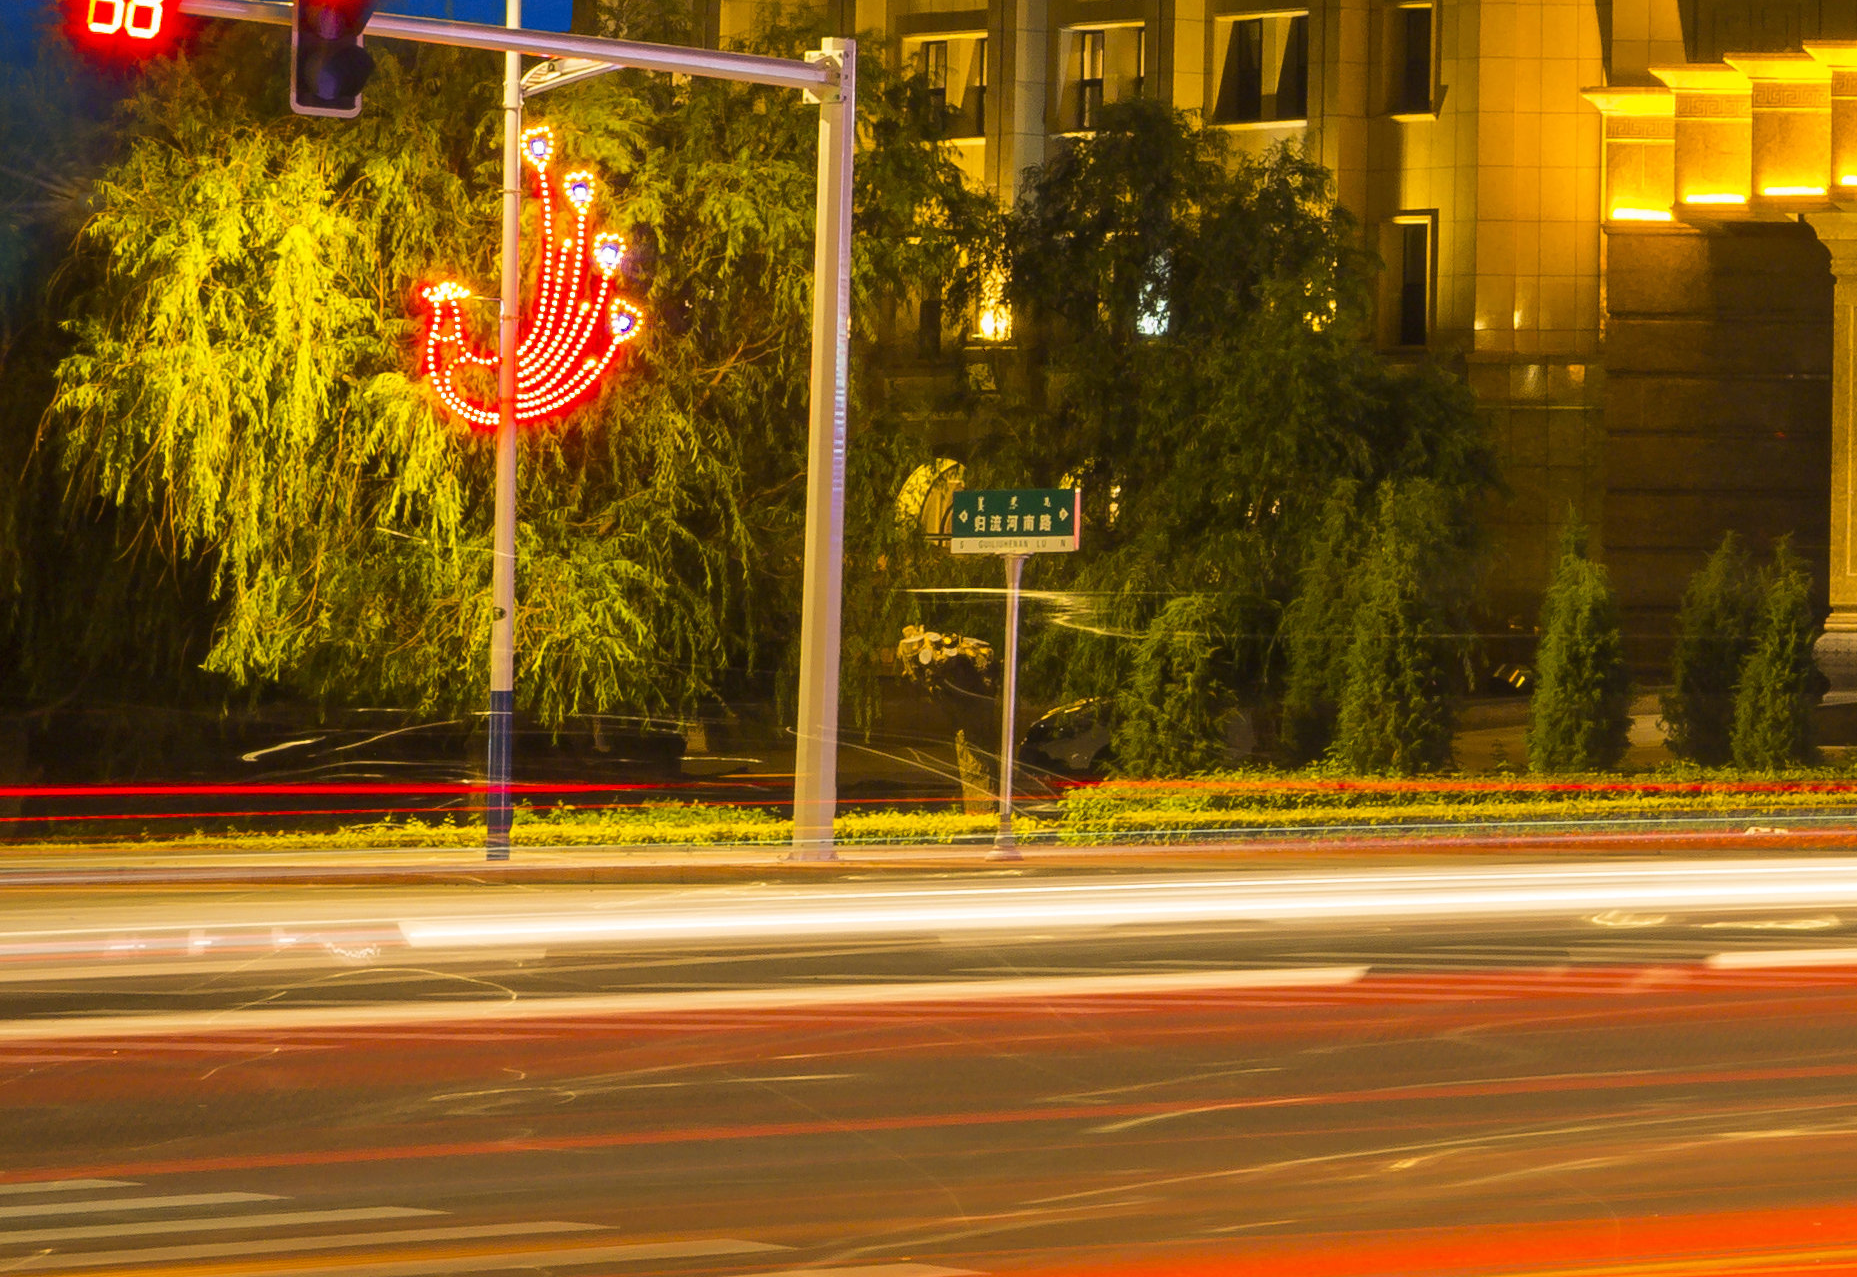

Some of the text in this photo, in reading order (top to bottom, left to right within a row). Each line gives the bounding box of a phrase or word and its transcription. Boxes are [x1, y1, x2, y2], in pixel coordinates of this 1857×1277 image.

[974, 513, 1052, 532] 归流河南路
